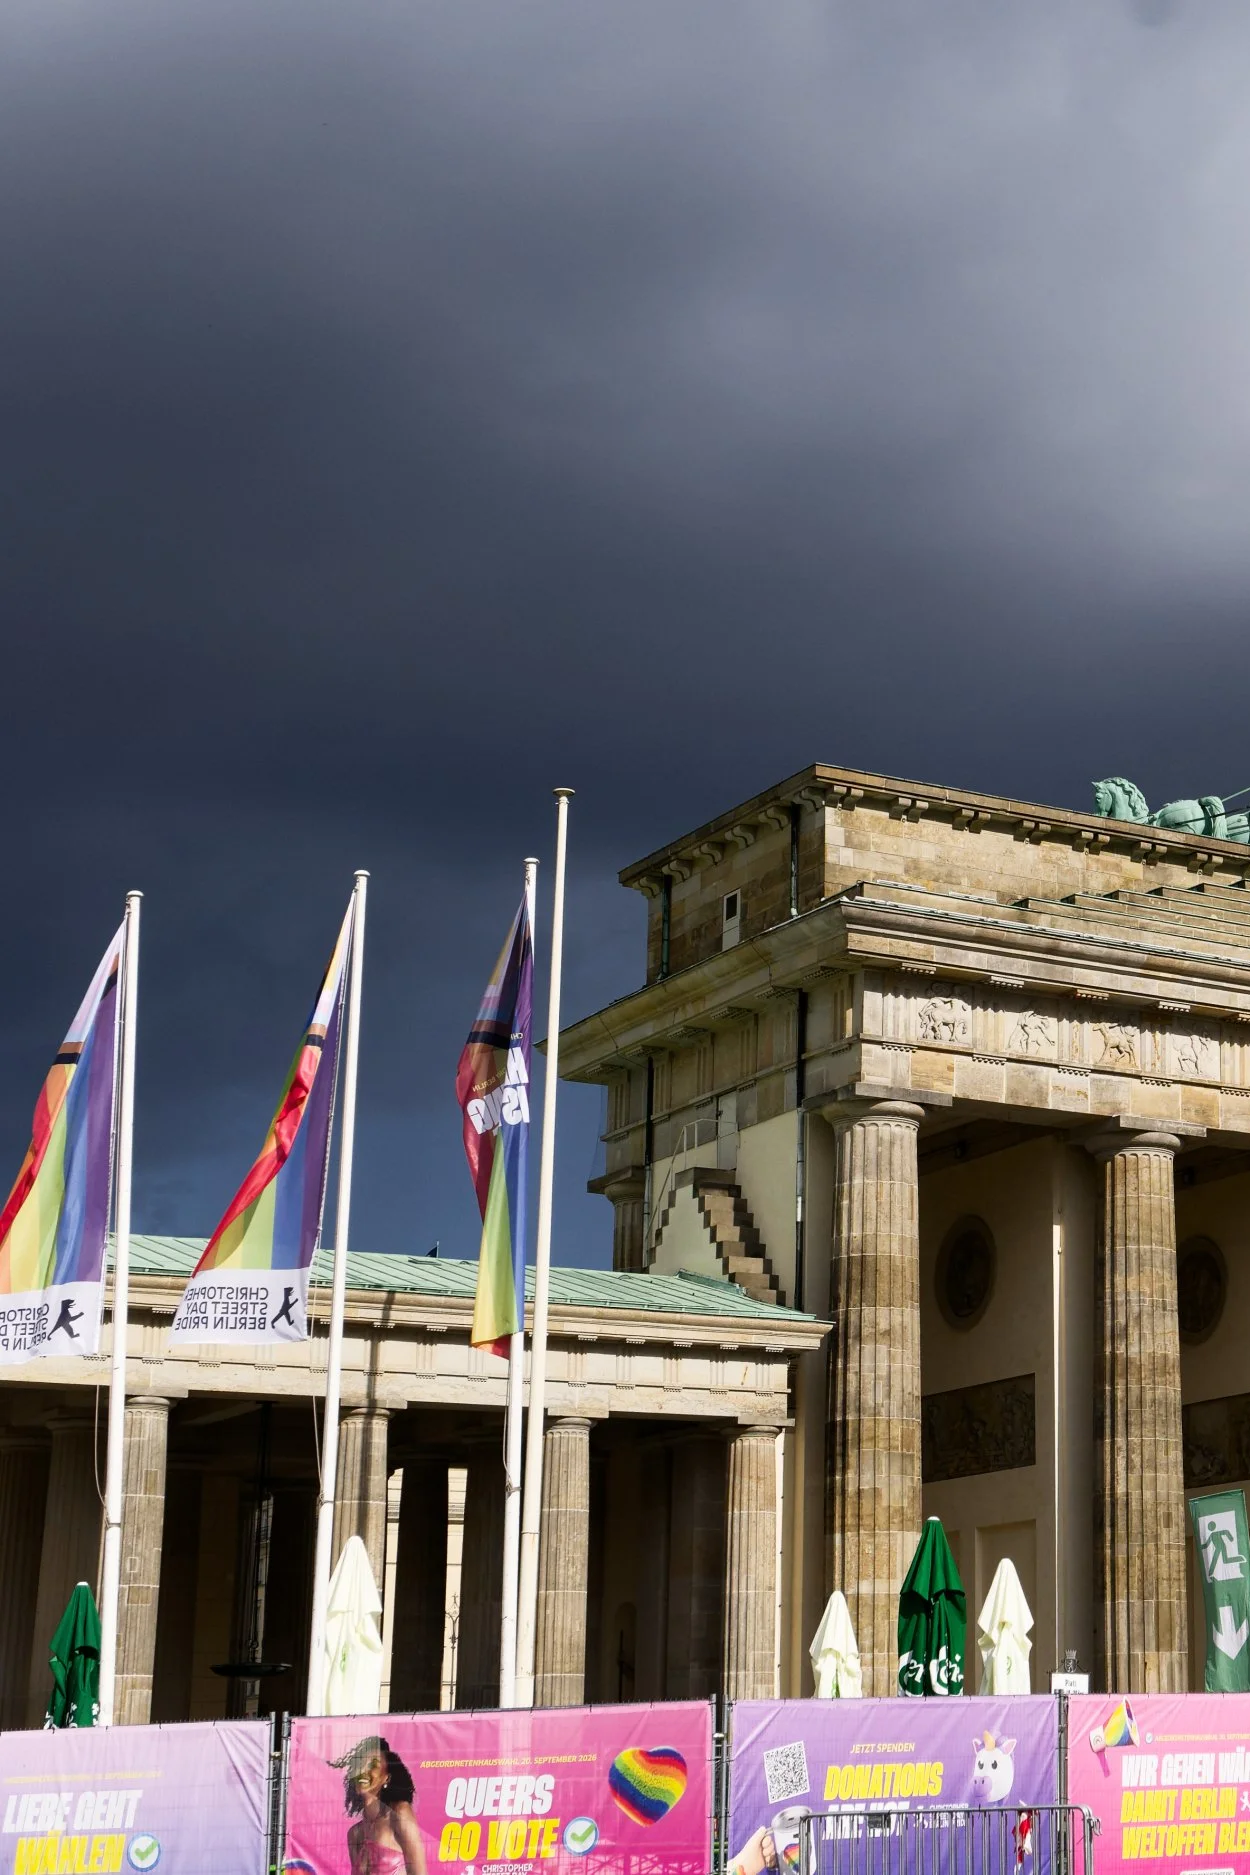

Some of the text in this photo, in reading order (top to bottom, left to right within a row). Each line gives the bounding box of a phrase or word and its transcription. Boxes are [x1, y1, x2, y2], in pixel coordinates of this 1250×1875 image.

[533, 1756, 577, 1765] SEPTEMBER
[578, 1754, 597, 1762] 2026
[850, 1742, 915, 1754] JETZT SPENDEN
[823, 1761, 944, 1801] DONATIONS
[1121, 1754, 1159, 1787] WIR
[1160, 1753, 1216, 1786] GEHEN
[2, 1789, 144, 1833] LIEBE GEHT
[445, 1774, 555, 1819] QUEERS
[1120, 1787, 1237, 1824] DAMIT BERLIN
[14, 1829, 126, 1875] WÄHLEN
[438, 1818, 560, 1862] GO VOTE
[1122, 1823, 1217, 1860] WELTOFFEN
[481, 1863, 533, 1873] CHRISTOPHER
